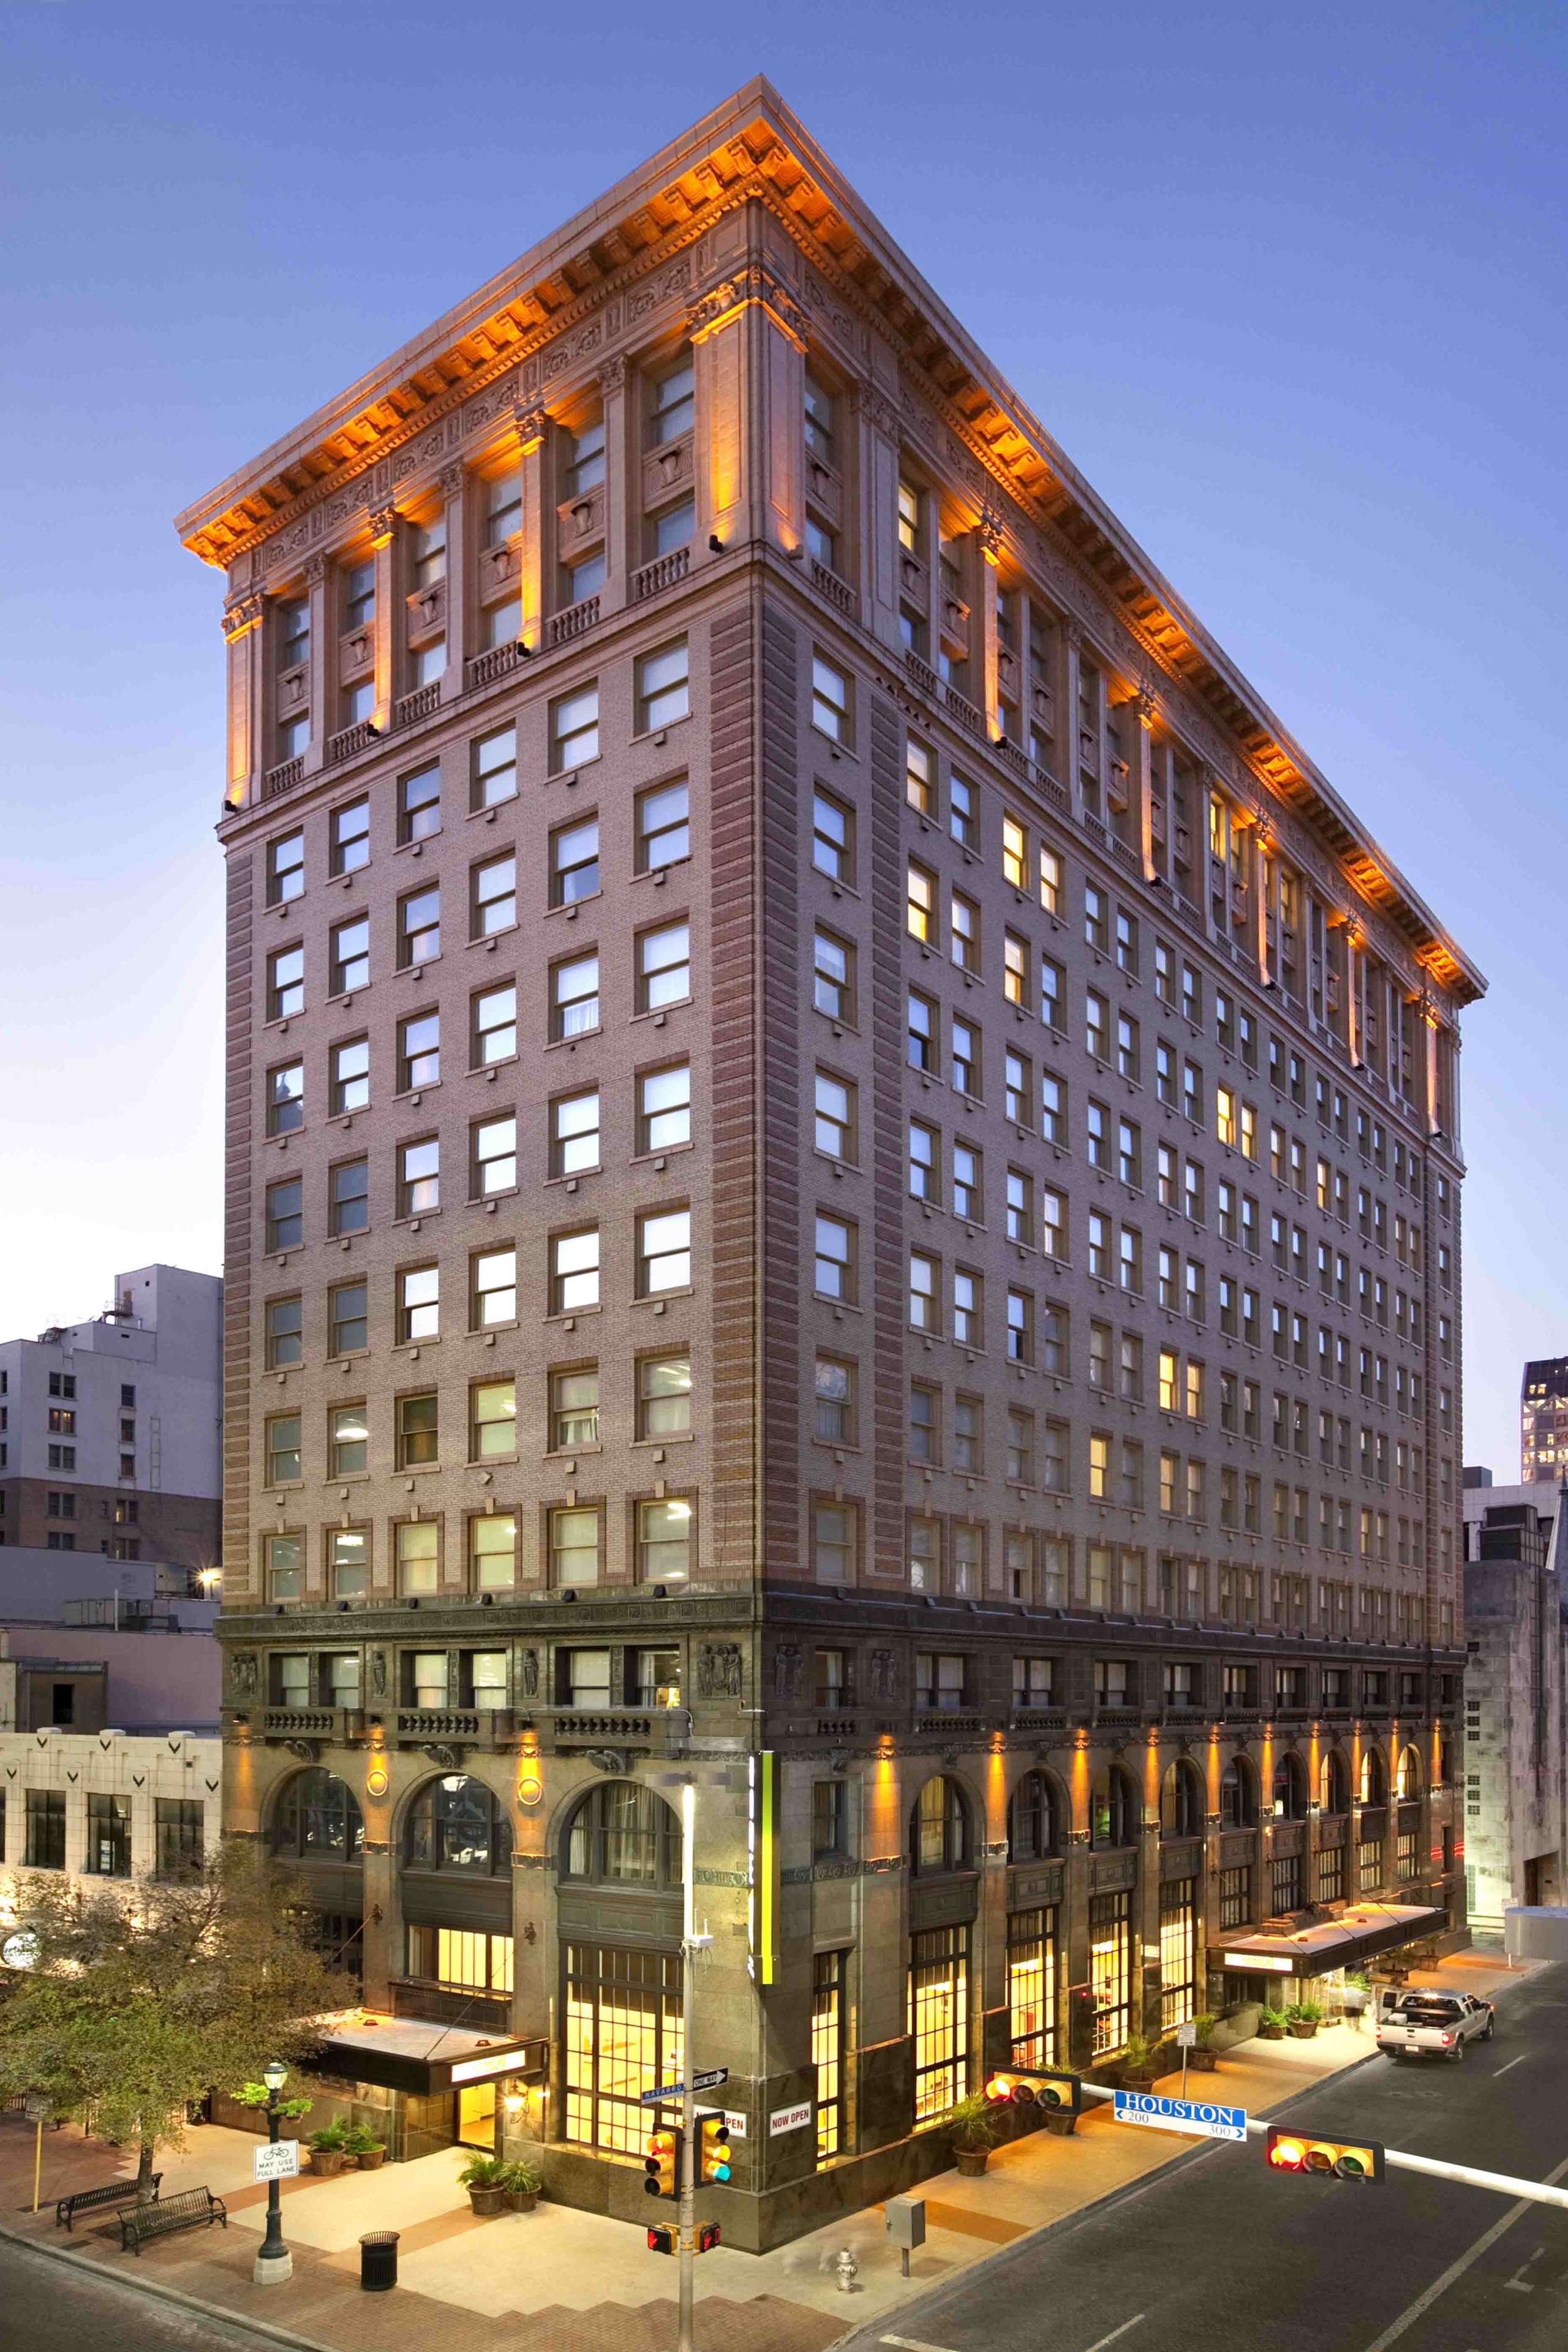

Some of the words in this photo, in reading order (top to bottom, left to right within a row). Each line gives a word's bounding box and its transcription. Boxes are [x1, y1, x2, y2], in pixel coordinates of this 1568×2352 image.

[707, 2075, 717, 2084] WAY
[645, 2084, 682, 2098] NAVARRO
[1124, 2093, 1235, 2125] HOUSTON
[726, 2117, 744, 2130] PEN
[772, 2116, 789, 2128] NOW
[791, 2108, 809, 2123] OPEN
[1128, 2111, 1149, 2123] 200
[1209, 2125, 1231, 2137] 300
